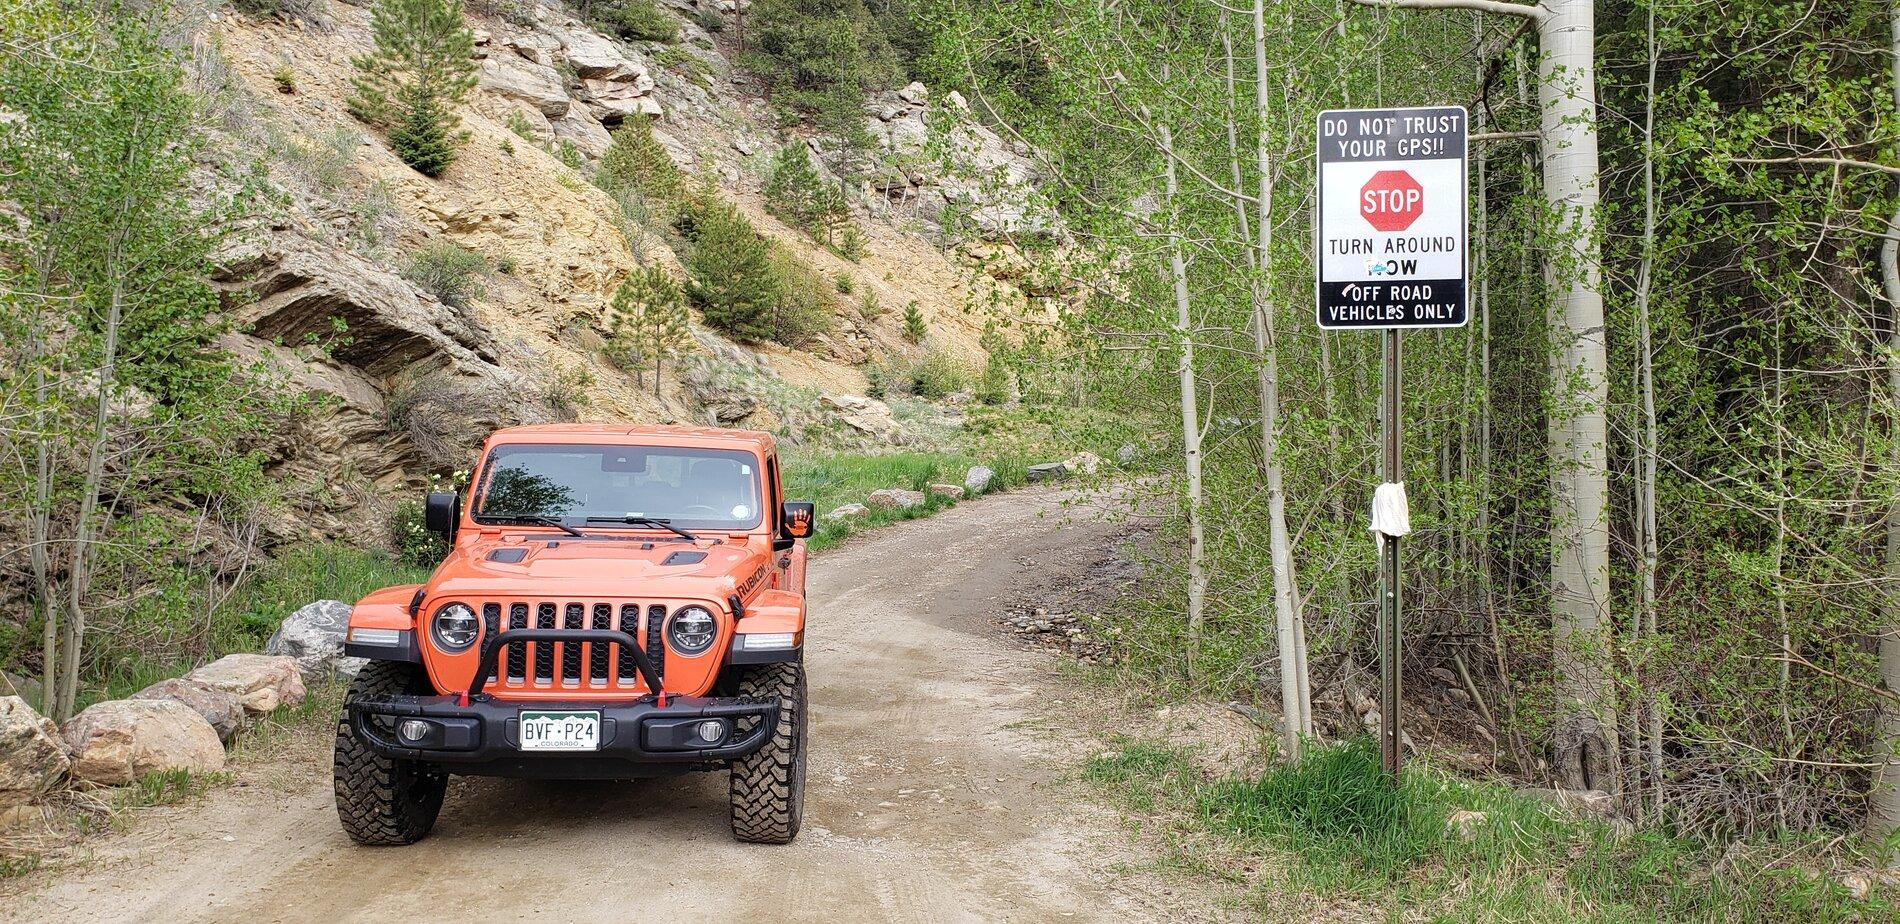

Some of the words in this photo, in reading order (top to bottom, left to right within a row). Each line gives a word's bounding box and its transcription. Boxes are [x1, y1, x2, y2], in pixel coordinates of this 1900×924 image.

[1325, 119, 1347, 136] DO
[1360, 118, 1391, 135] NOT
[1404, 116, 1459, 134] TRUST
[1338, 140, 1386, 157] YOUR
[1398, 138, 1444, 155] GPS!!
[1363, 189, 1420, 214] STOP
[1330, 239, 1373, 255] TURN
[1385, 237, 1455, 254] AROUND
[1369, 260, 1417, 276] OW
[1352, 286, 1380, 301] OFF
[1391, 285, 1432, 300] ROAD
[1329, 305, 1404, 320] VEHICLES
[1414, 304, 1455, 319] ONLY
[736, 564, 766, 599] RUBICON
